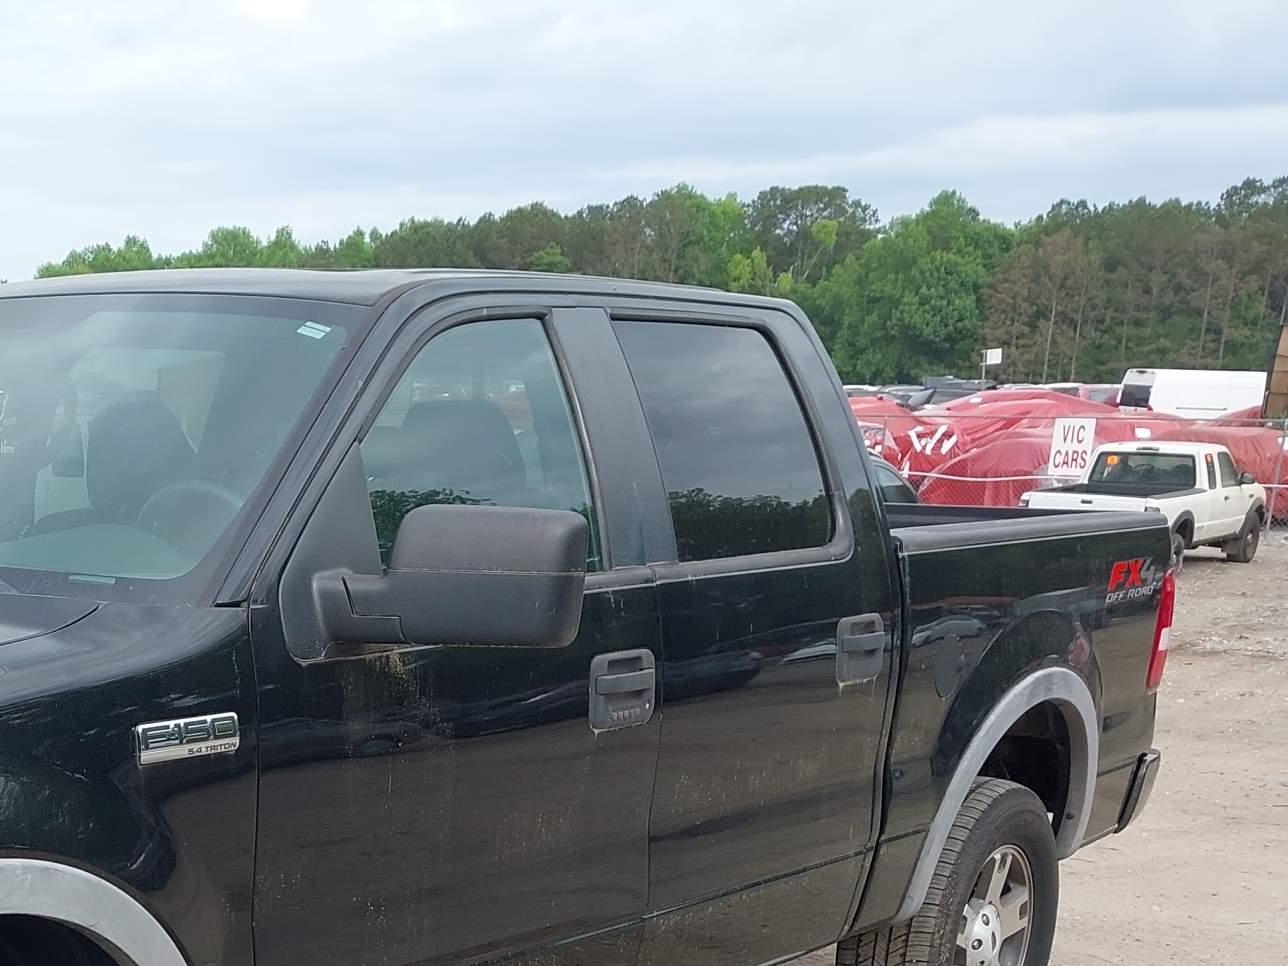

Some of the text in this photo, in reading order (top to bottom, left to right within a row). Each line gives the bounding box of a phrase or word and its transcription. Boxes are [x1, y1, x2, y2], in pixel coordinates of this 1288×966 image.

[1062, 424, 1086, 444] VIC
[1053, 449, 1088, 469] CARS
[1107, 556, 1156, 593] FX4
[1105, 585, 1154, 603] OFF ROAD
[205, 741, 237, 753] TRITON
